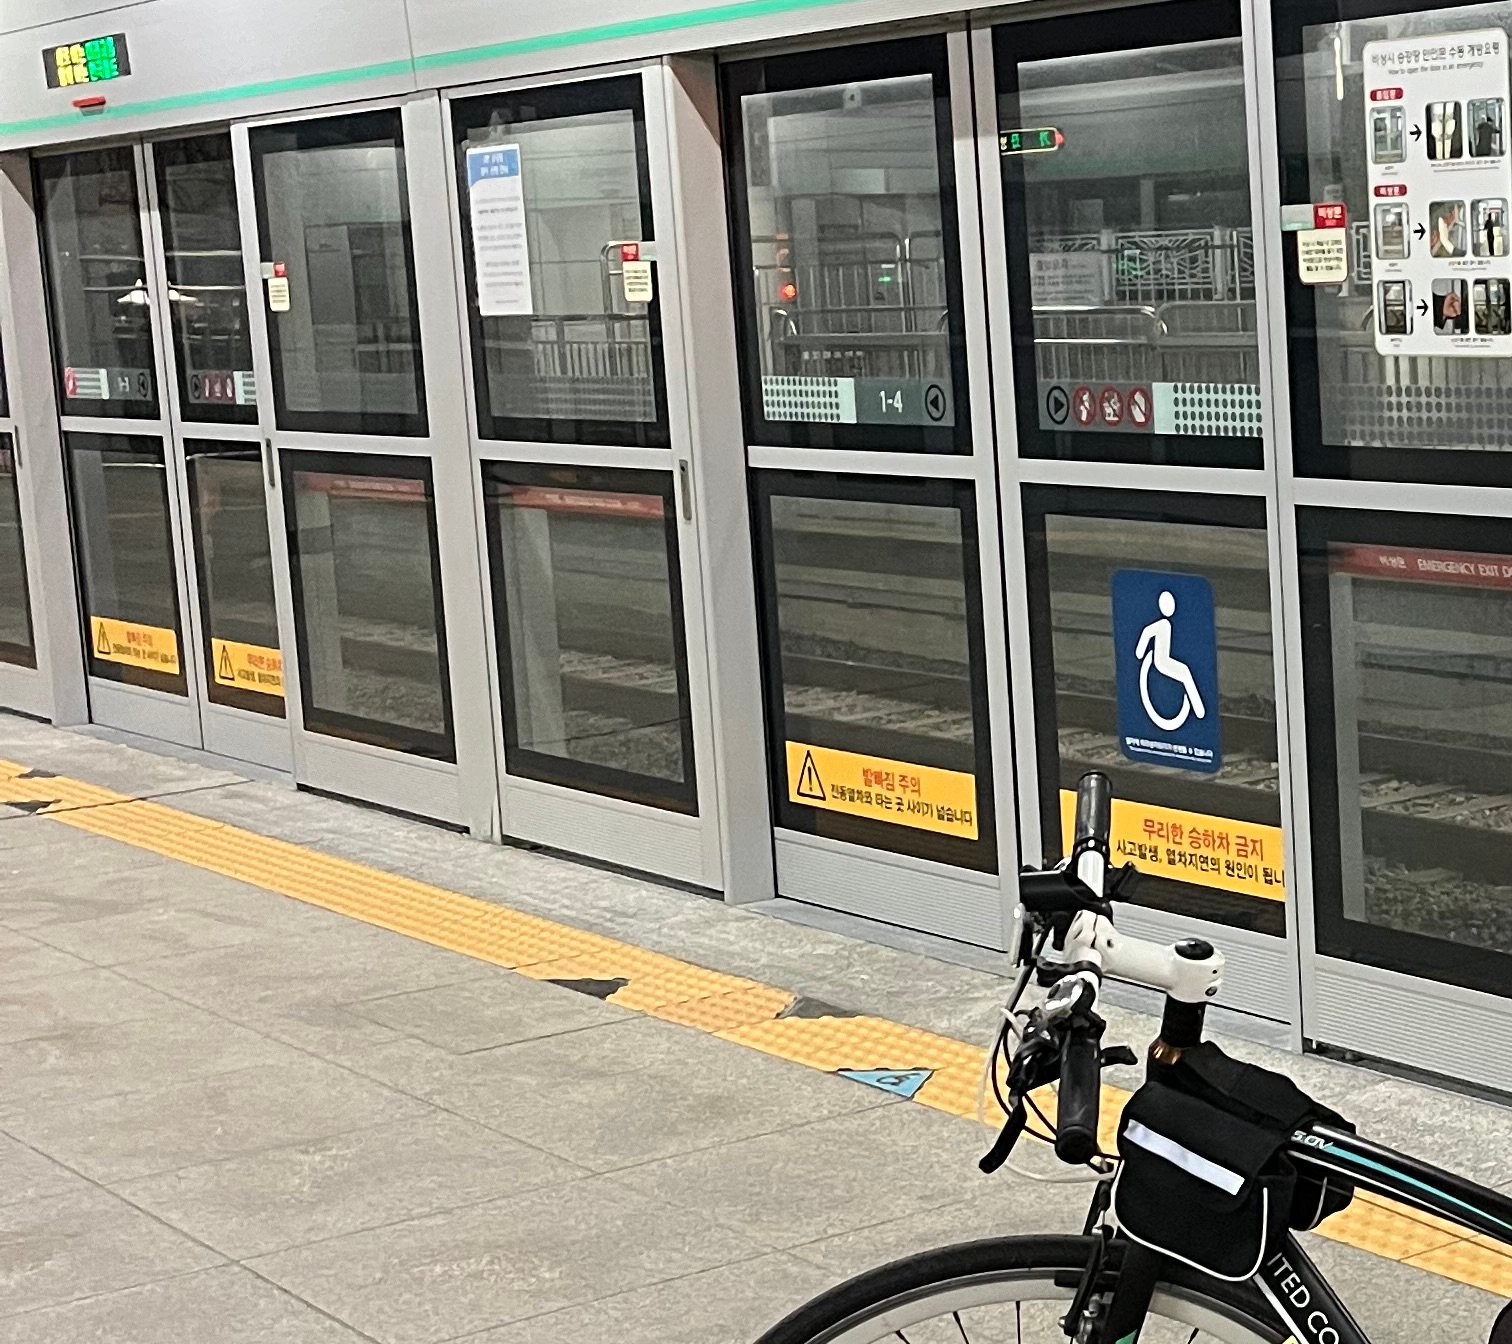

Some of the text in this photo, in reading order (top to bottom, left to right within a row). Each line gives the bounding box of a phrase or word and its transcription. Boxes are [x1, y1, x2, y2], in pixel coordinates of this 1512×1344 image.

[879, 390, 903, 413] 1-4
[1417, 558, 1476, 576] EMERGENCY
[1478, 563, 1500, 577] EXIT
[862, 767, 922, 797] 발빠짐 주의
[875, 793, 893, 809] 타는
[1142, 818, 1264, 862] 무리한 승하차 금지
[1116, 838, 1163, 864] 사고발생,
[1166, 847, 1221, 875] 열차지연의
[1224, 858, 1258, 883] 원인이
[1266, 1251, 1311, 1309] ITED
